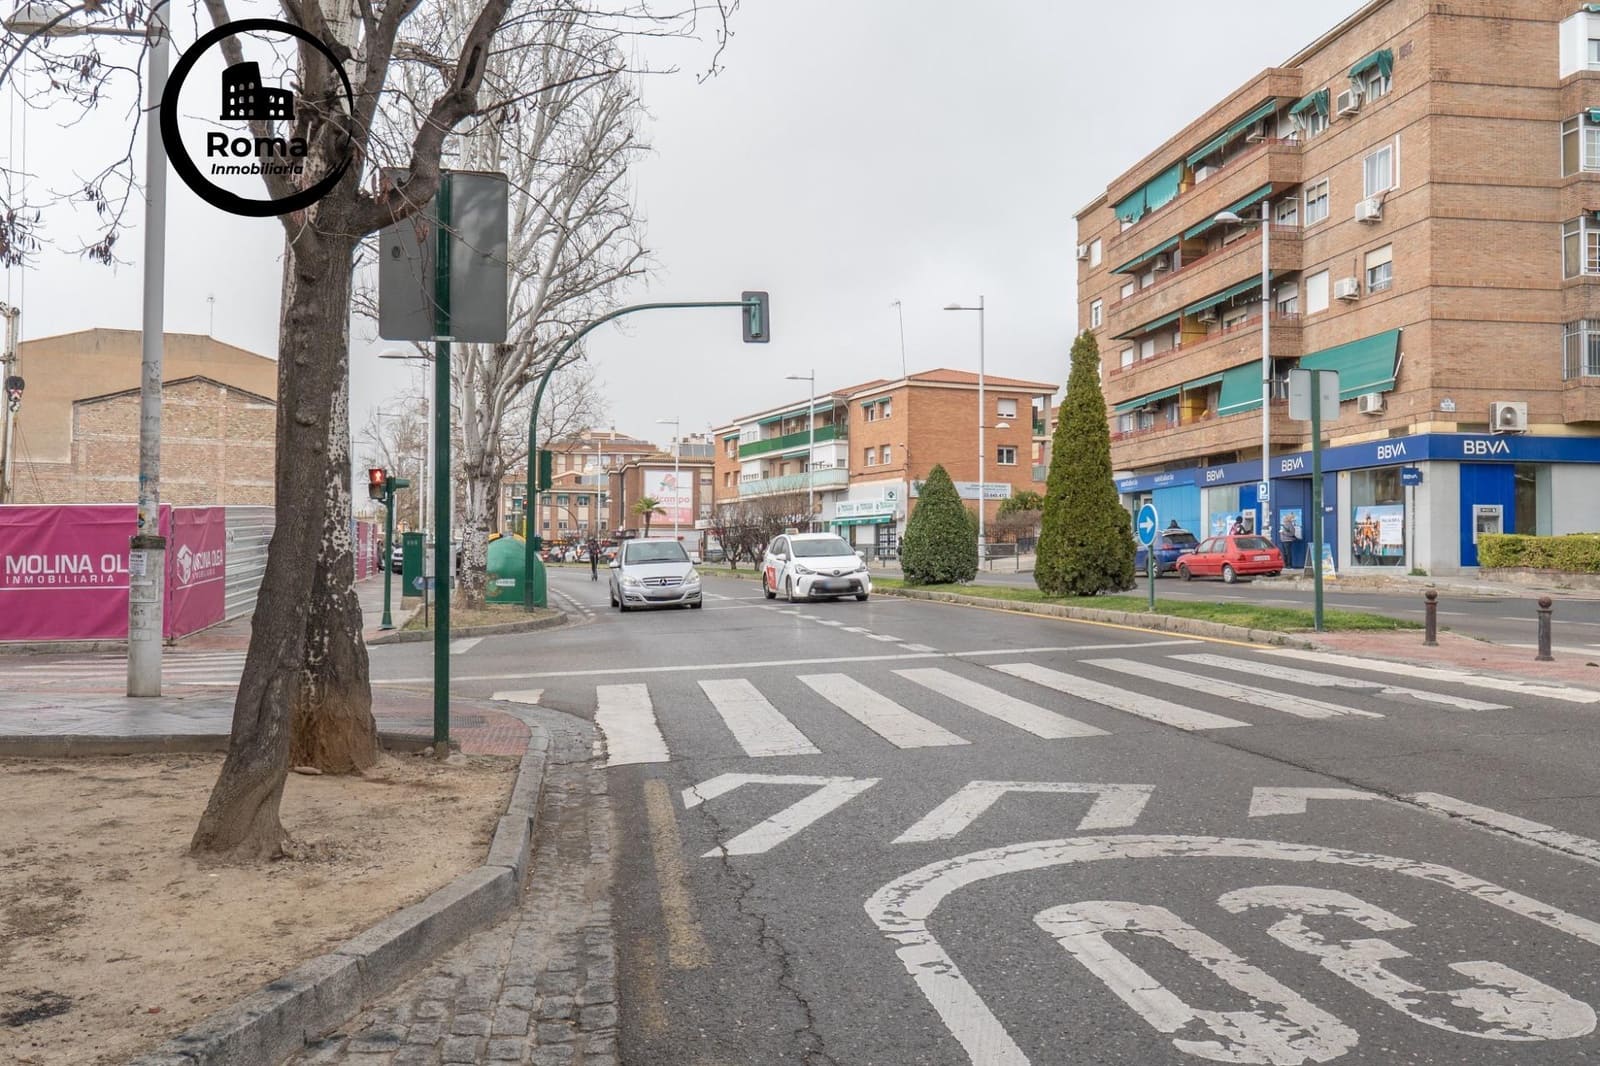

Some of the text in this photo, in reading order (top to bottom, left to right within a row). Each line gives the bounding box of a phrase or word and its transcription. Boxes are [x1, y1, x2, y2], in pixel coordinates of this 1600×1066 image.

[1377, 441, 1407, 460] BBVA
[1463, 439, 1510, 455] BBVA
[1281, 456, 1304, 472] BBVA
[1206, 469, 1225, 482] BBVA
[6, 554, 93, 574] MOLINA
[100, 554, 129, 574] OL
[6, 574, 115, 585] INMOBILIARIA
